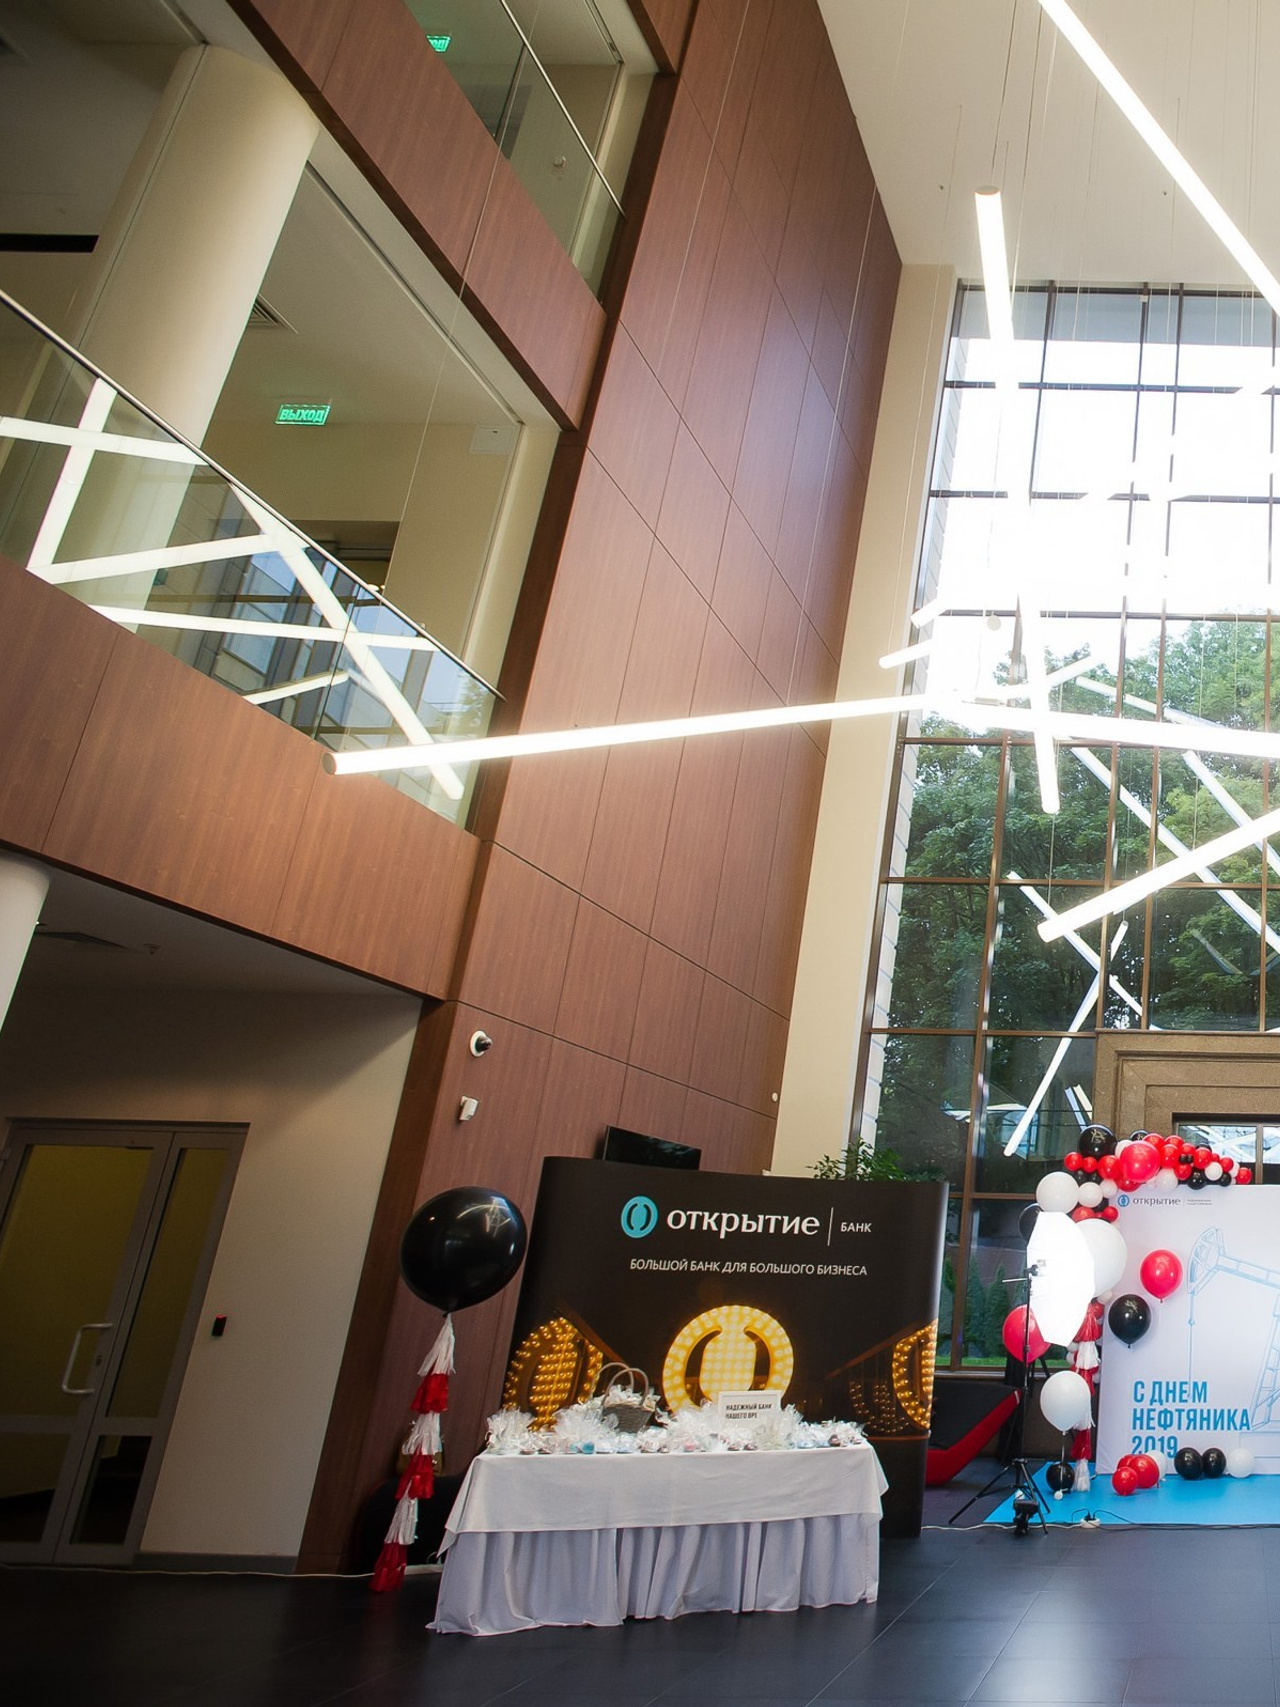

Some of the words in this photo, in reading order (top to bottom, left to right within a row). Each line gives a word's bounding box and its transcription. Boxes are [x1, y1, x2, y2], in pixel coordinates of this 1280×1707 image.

[280, 408, 325, 422] ВЫХОД
[1132, 1197, 1181, 1206] открытие
[666, 1209, 820, 1239] открытие
[840, 1222, 872, 1233] БАНК
[630, 1258, 688, 1272] БОЛЬШОЙ
[690, 1260, 720, 1273] БАНК
[721, 1262, 747, 1274] ДЛЯ
[749, 1262, 815, 1275] БОЛЬШОГО
[817, 1264, 868, 1276] БИЗНЕСА
[1133, 1380, 1145, 1403] С
[1149, 1381, 1207, 1406] ДНЕМ
[1132, 1408, 1251, 1431] НЕФТЯНИКА
